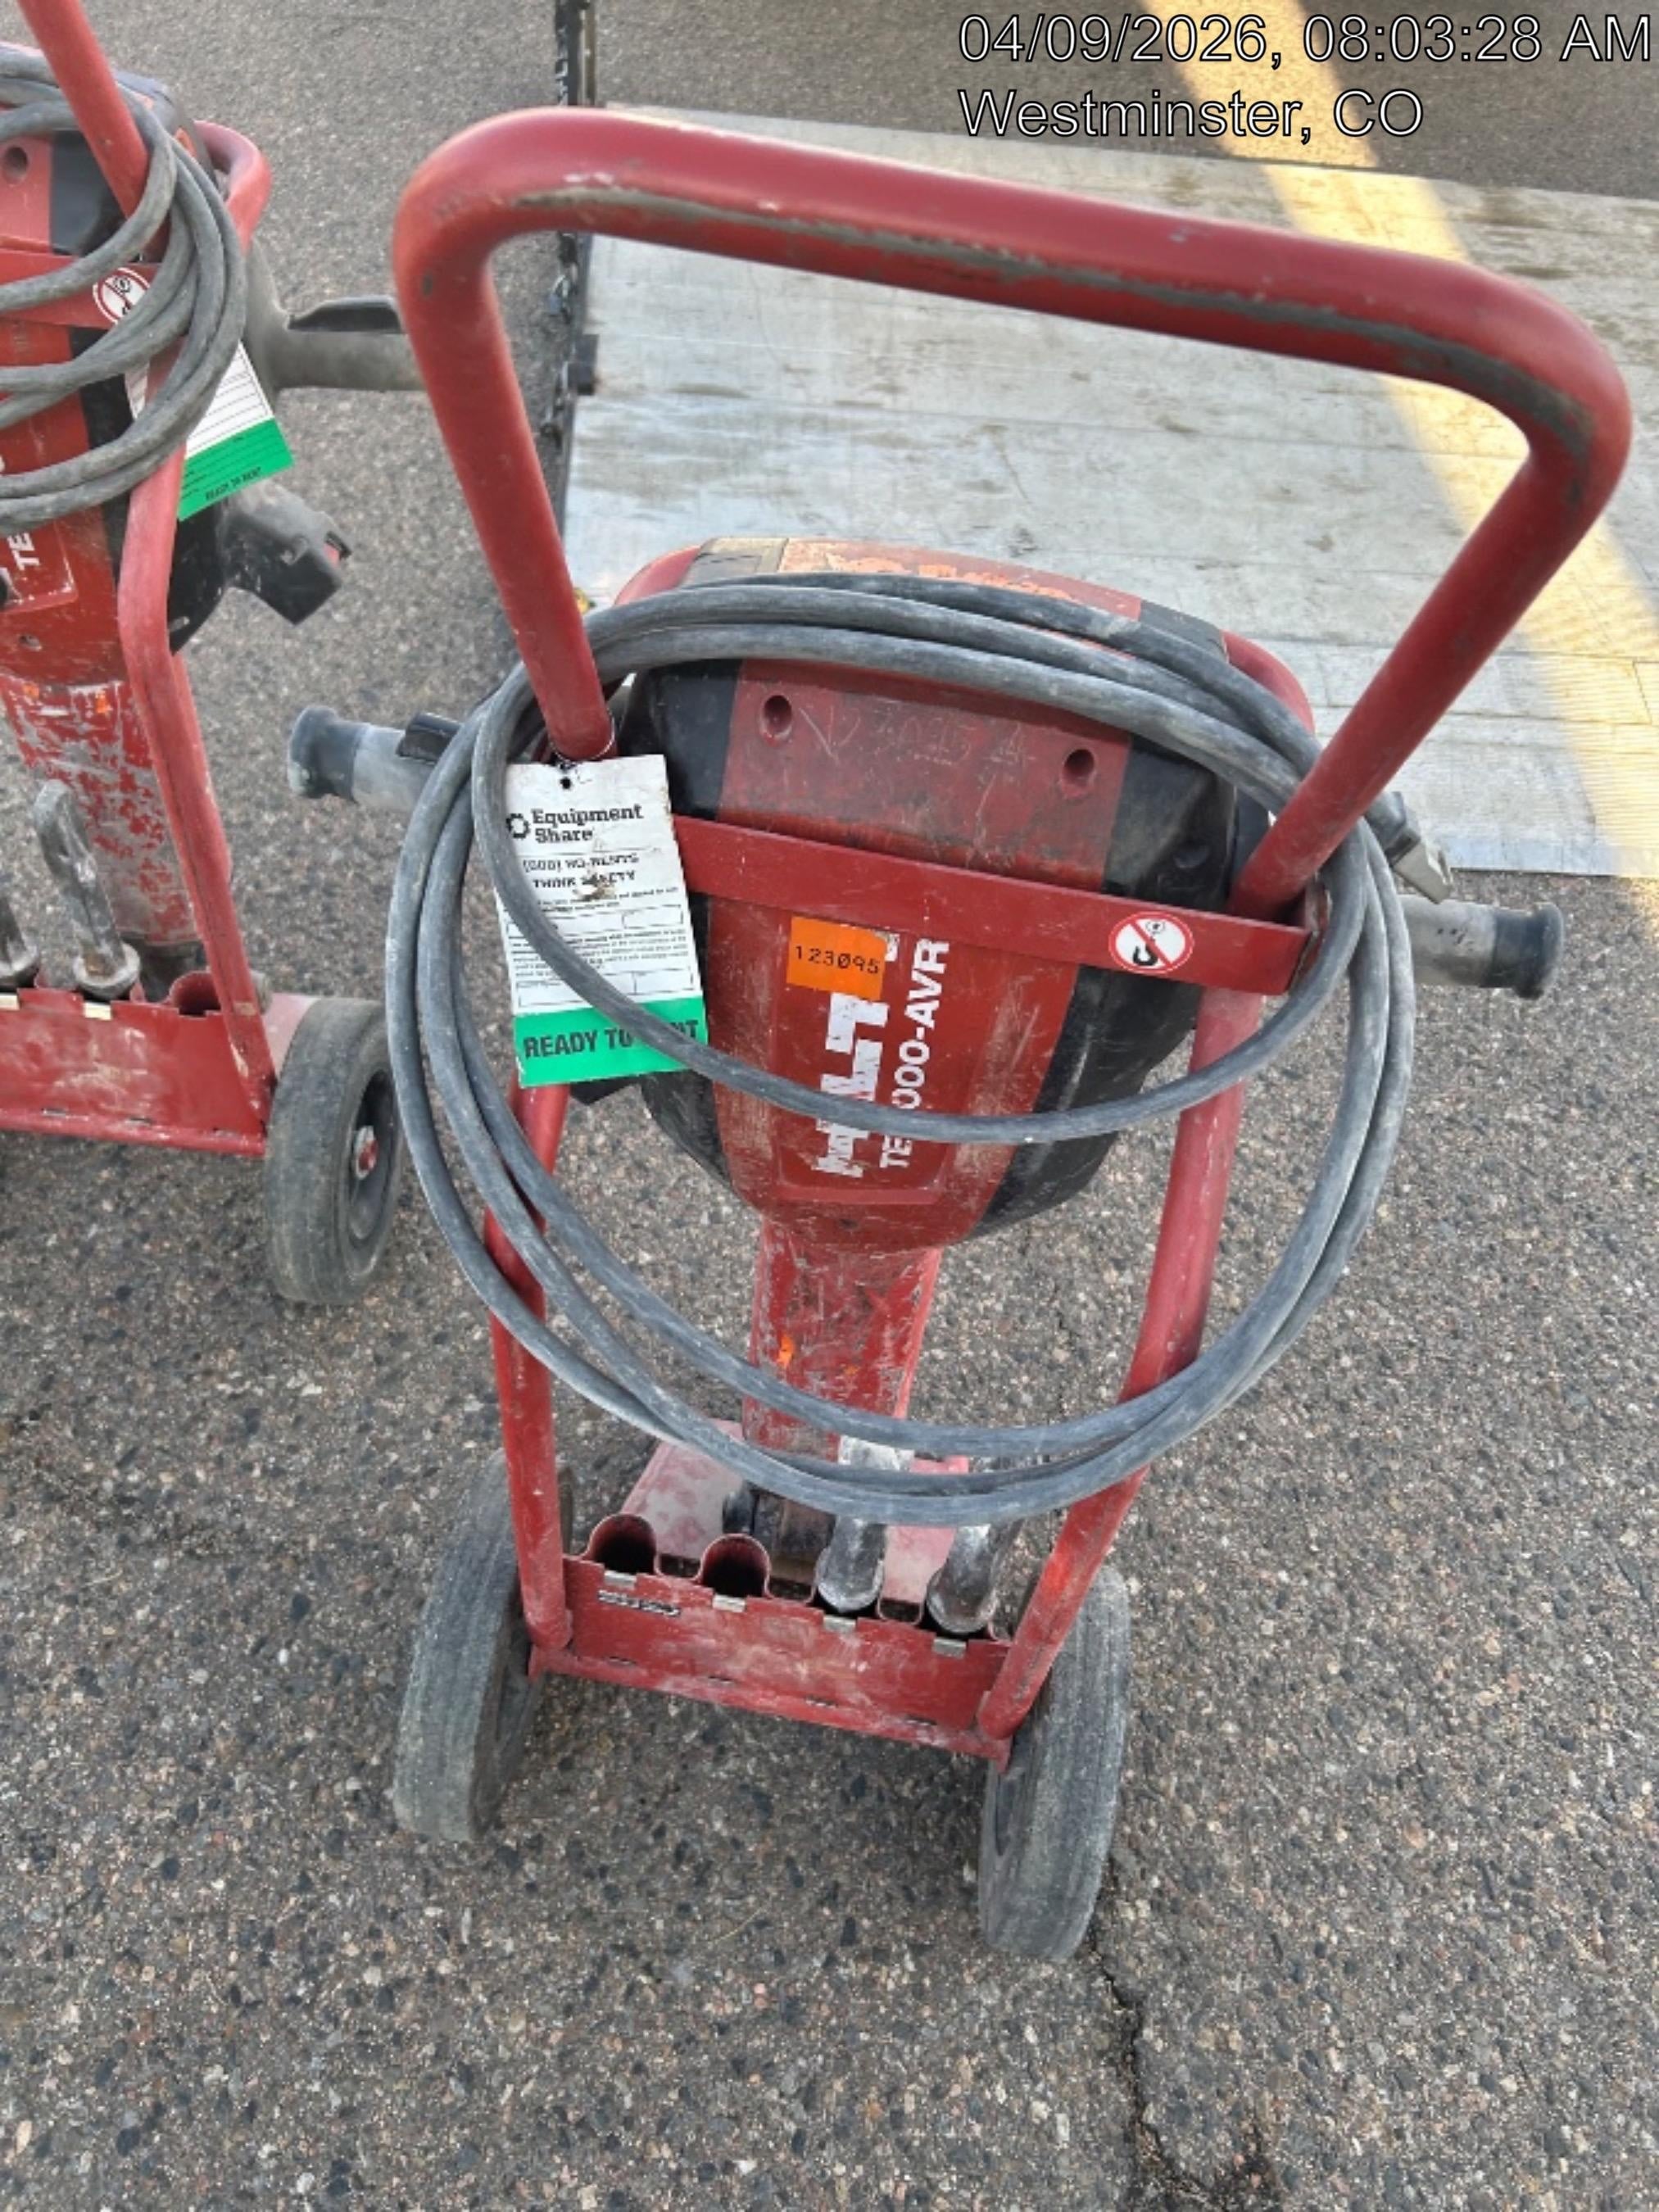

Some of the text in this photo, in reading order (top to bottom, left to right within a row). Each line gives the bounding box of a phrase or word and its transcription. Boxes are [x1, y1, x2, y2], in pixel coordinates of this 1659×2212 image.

[531, 803, 644, 827] Equipment
[535, 827, 594, 844] Share
[795, 945, 879, 974] 123095
[891, 937, 950, 1110] 000-AVR
[523, 1029, 598, 1059] READY
